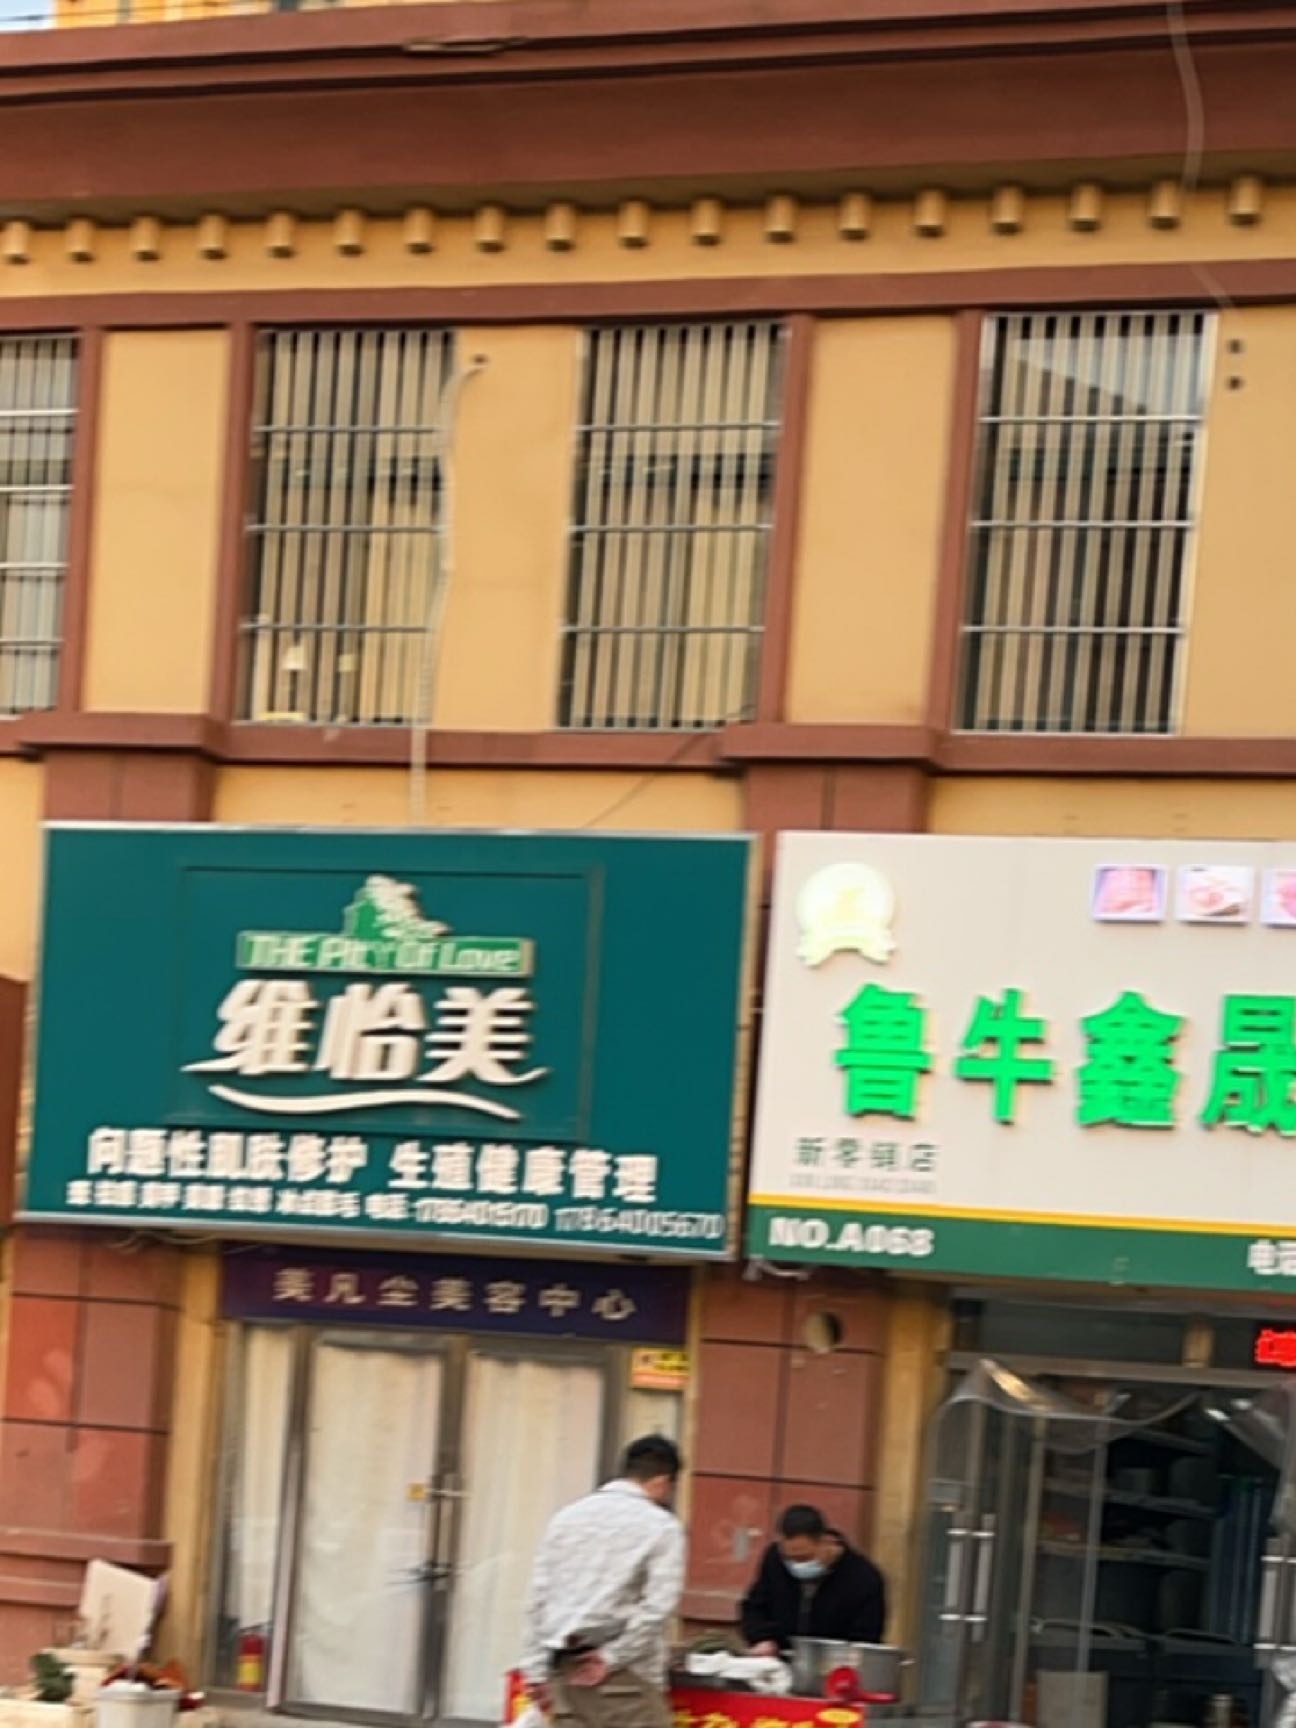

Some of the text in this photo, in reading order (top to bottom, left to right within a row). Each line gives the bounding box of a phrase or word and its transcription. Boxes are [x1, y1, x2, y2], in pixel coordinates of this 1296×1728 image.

[180, 978, 552, 1086] 维怡美
[87, 1127, 369, 1184] 问题性肌肤修护
[387, 1139, 658, 1203] 生殖健康管理
